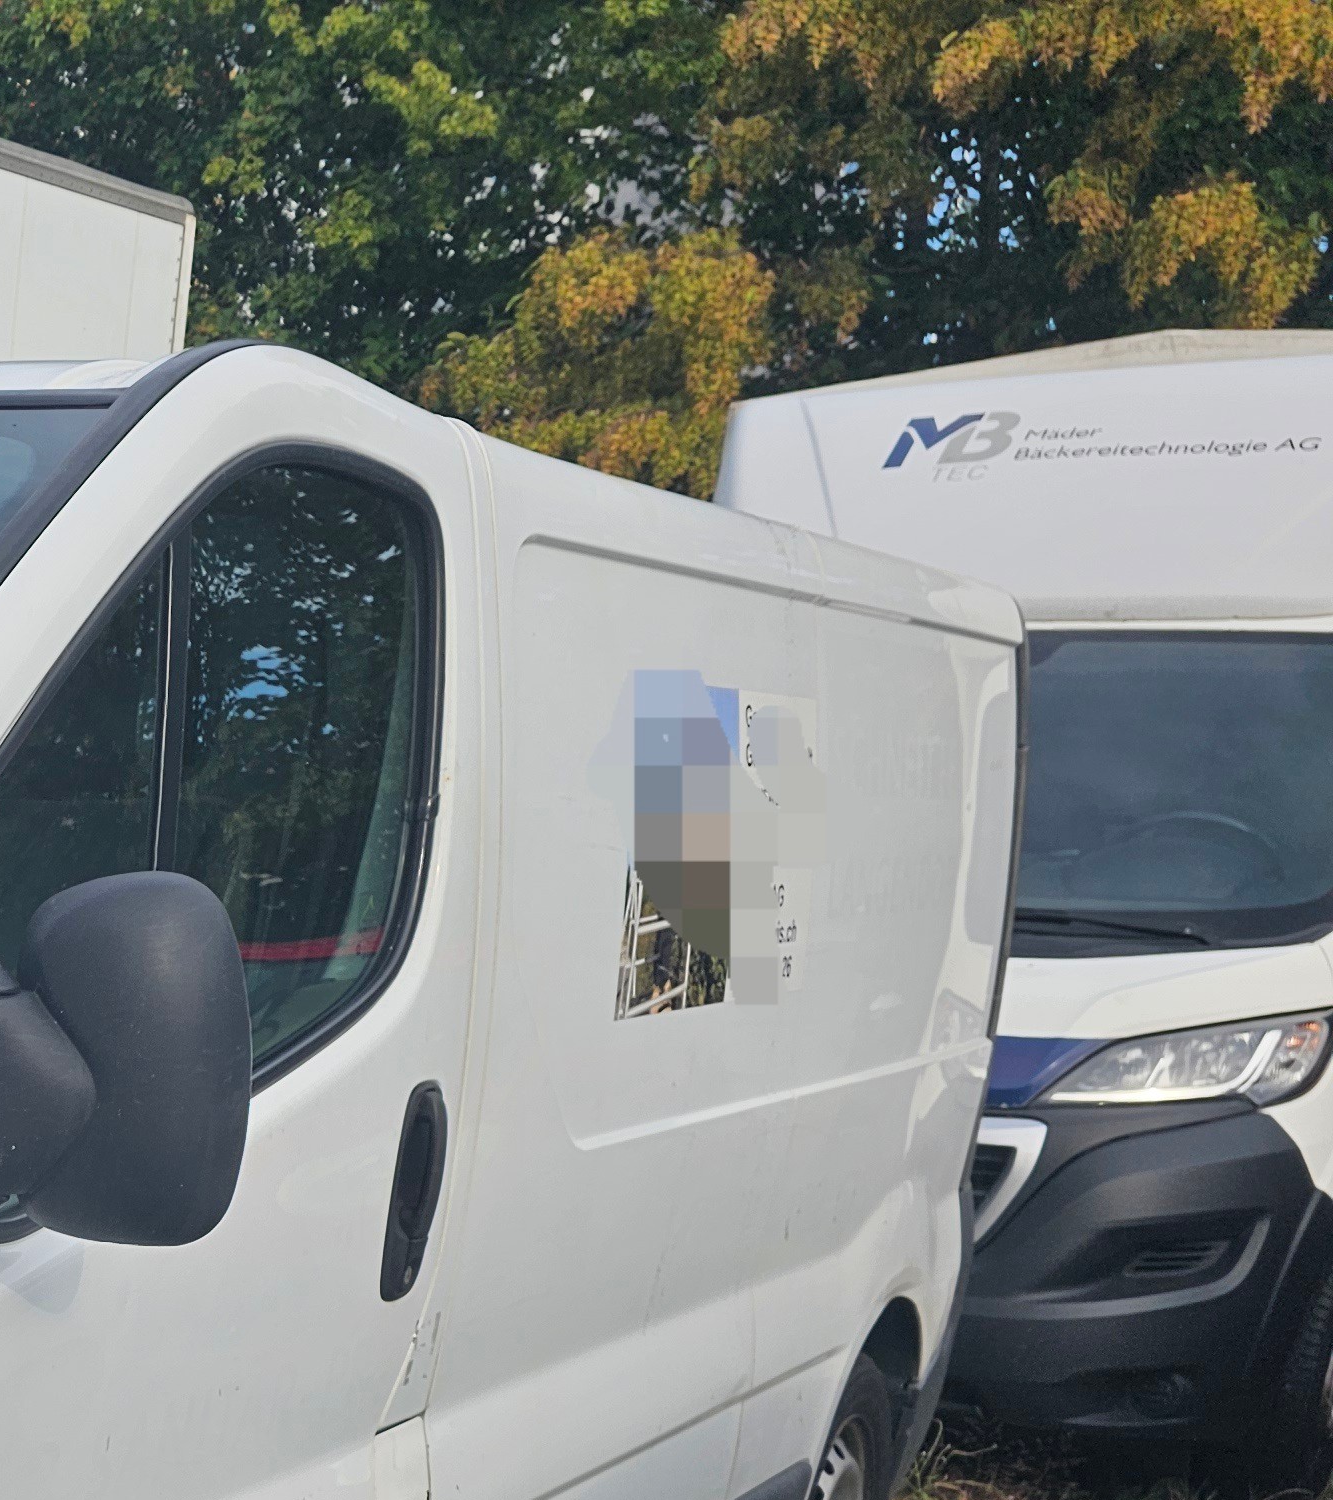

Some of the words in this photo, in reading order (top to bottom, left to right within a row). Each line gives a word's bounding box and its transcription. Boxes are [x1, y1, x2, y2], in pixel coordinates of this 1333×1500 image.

[1024, 426, 1103, 442] Mäder
[1013, 438, 1268, 462] Bäckereitechnologie
[1275, 436, 1323, 452] AG
[932, 464, 990, 483] TEC
